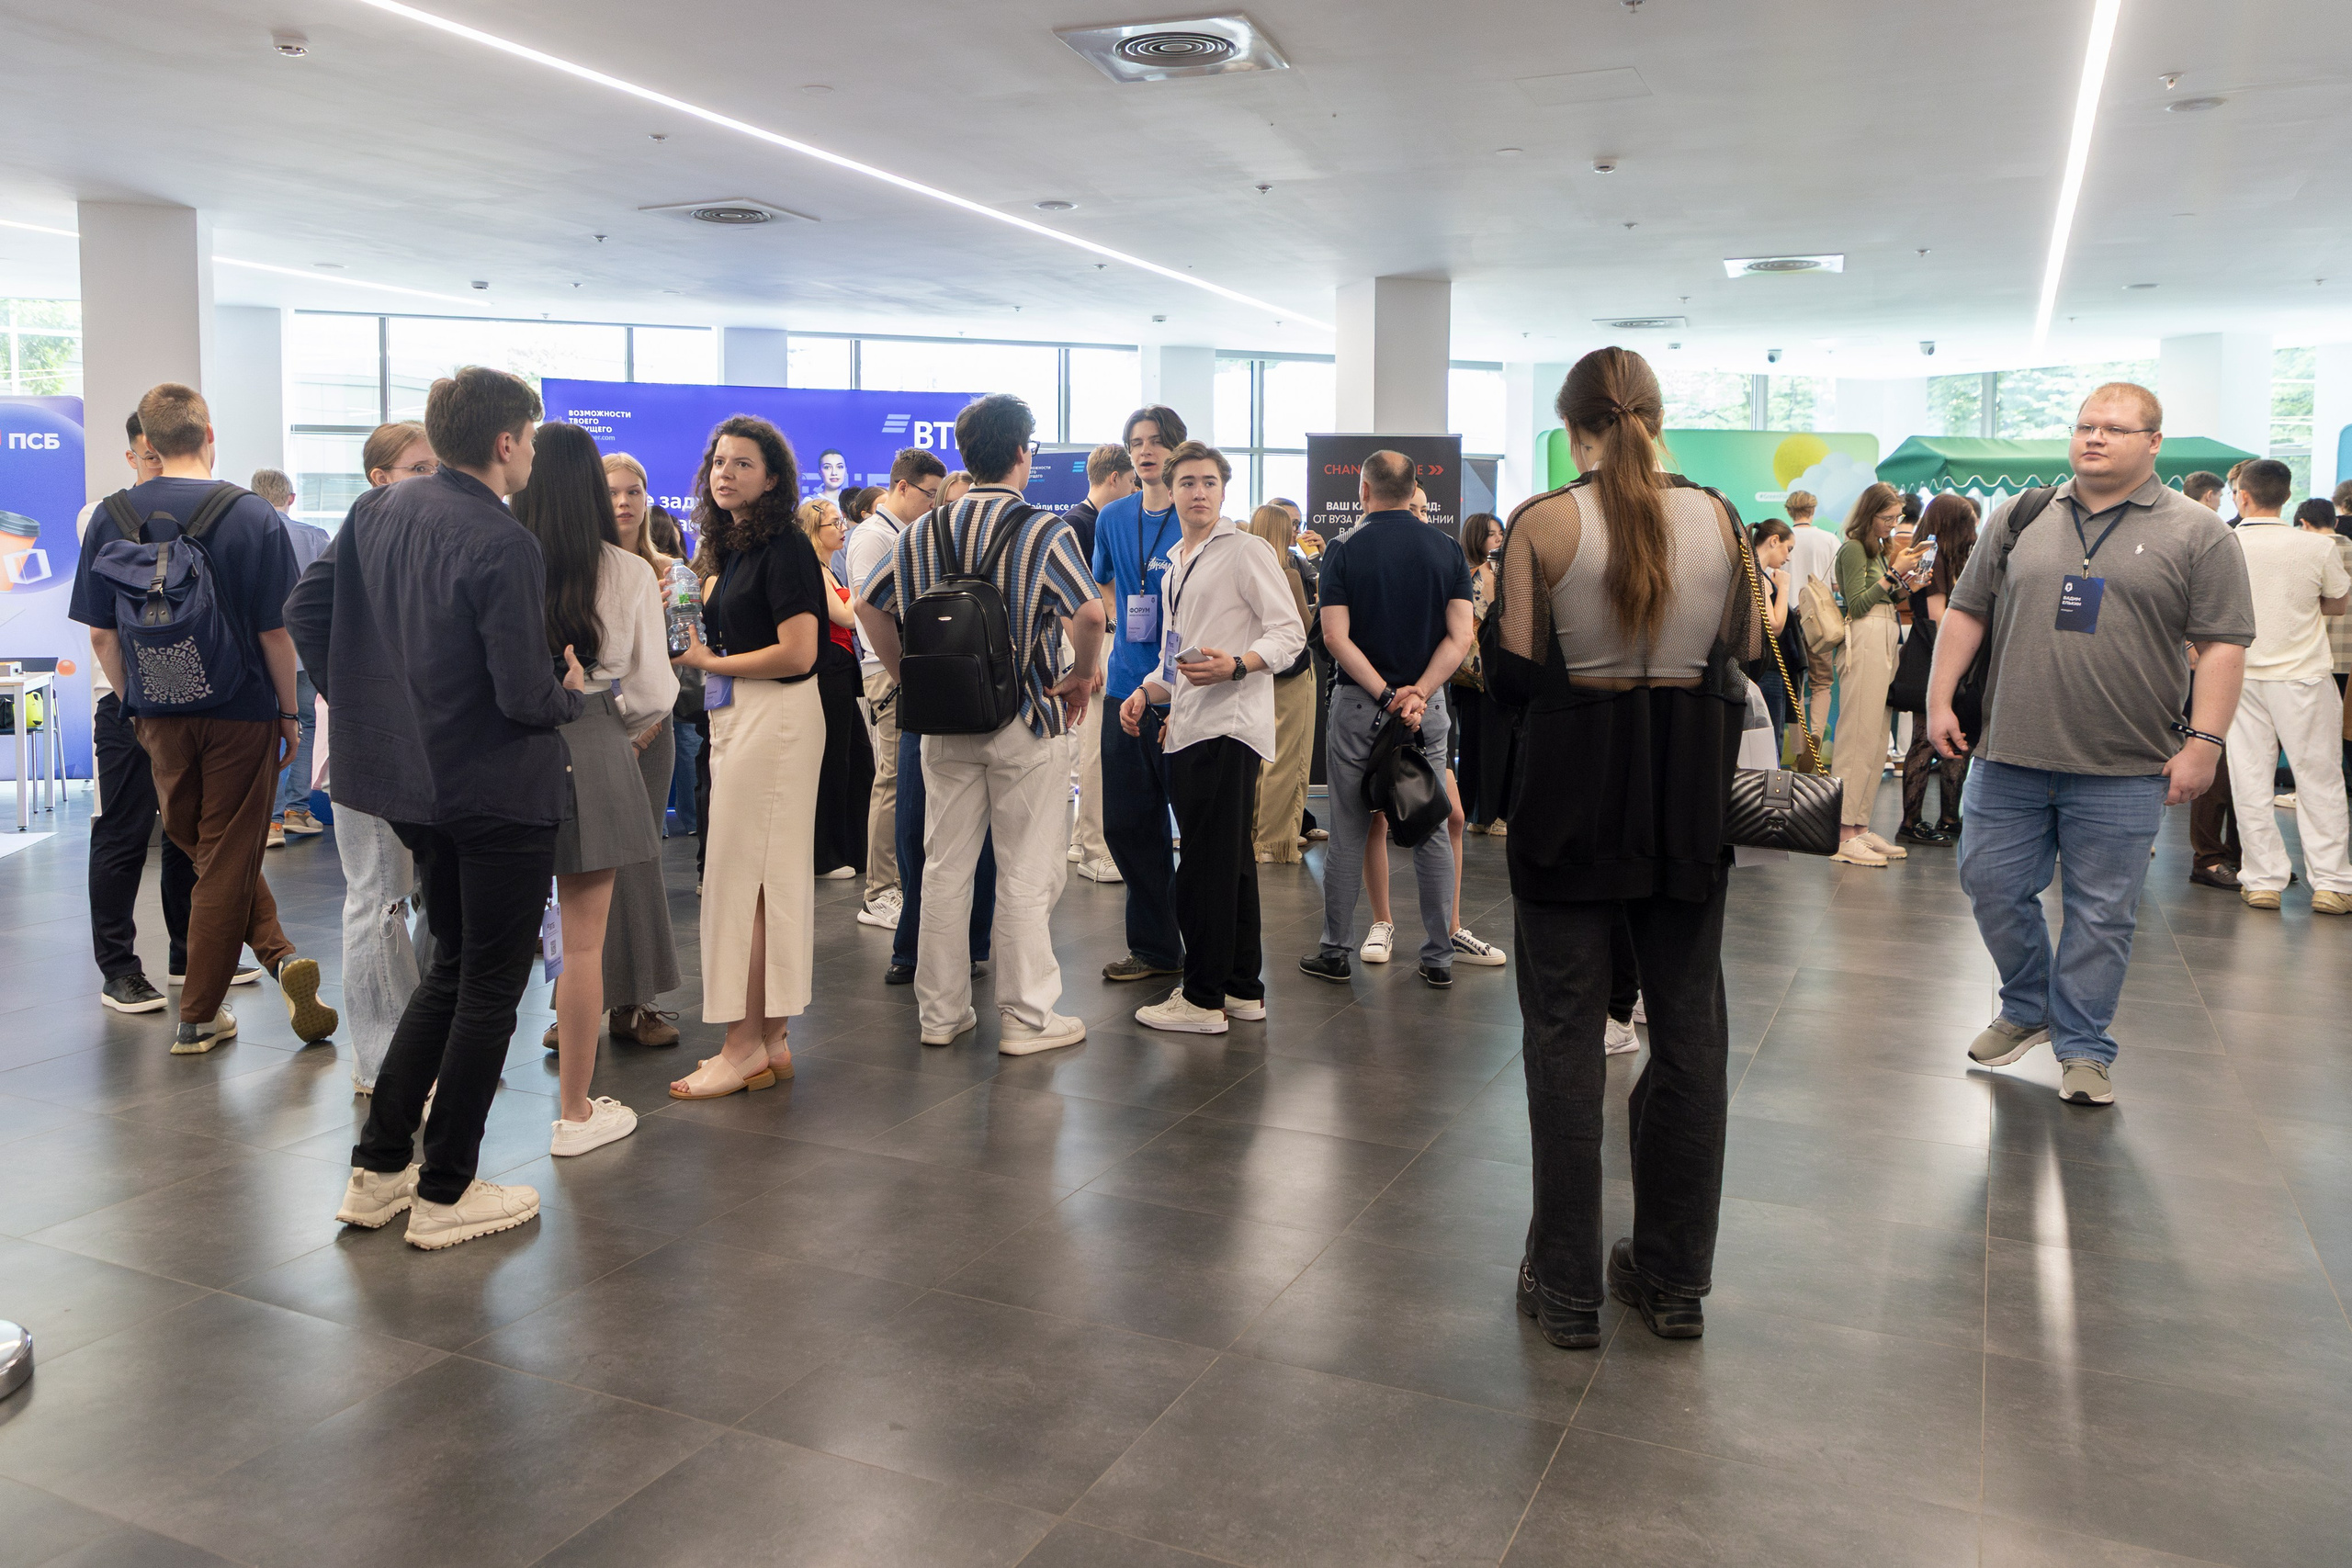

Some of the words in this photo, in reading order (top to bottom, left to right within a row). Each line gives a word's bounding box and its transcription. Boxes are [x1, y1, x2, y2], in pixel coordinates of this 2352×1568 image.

[568, 410, 632, 419] ВОЗМОЖНОСТИ
[568, 417, 600, 425] ТВОЕГО
[581, 425, 613, 434] УЩЕГО
[914, 422, 959, 450] ВТ
[8, 433, 61, 450] ПСБ
[1326, 502, 1350, 511] ВАШ
[1312, 515, 1327, 525] ОТ
[1329, 514, 1352, 525] ВУЗА
[1428, 515, 1454, 525] АНИИ
